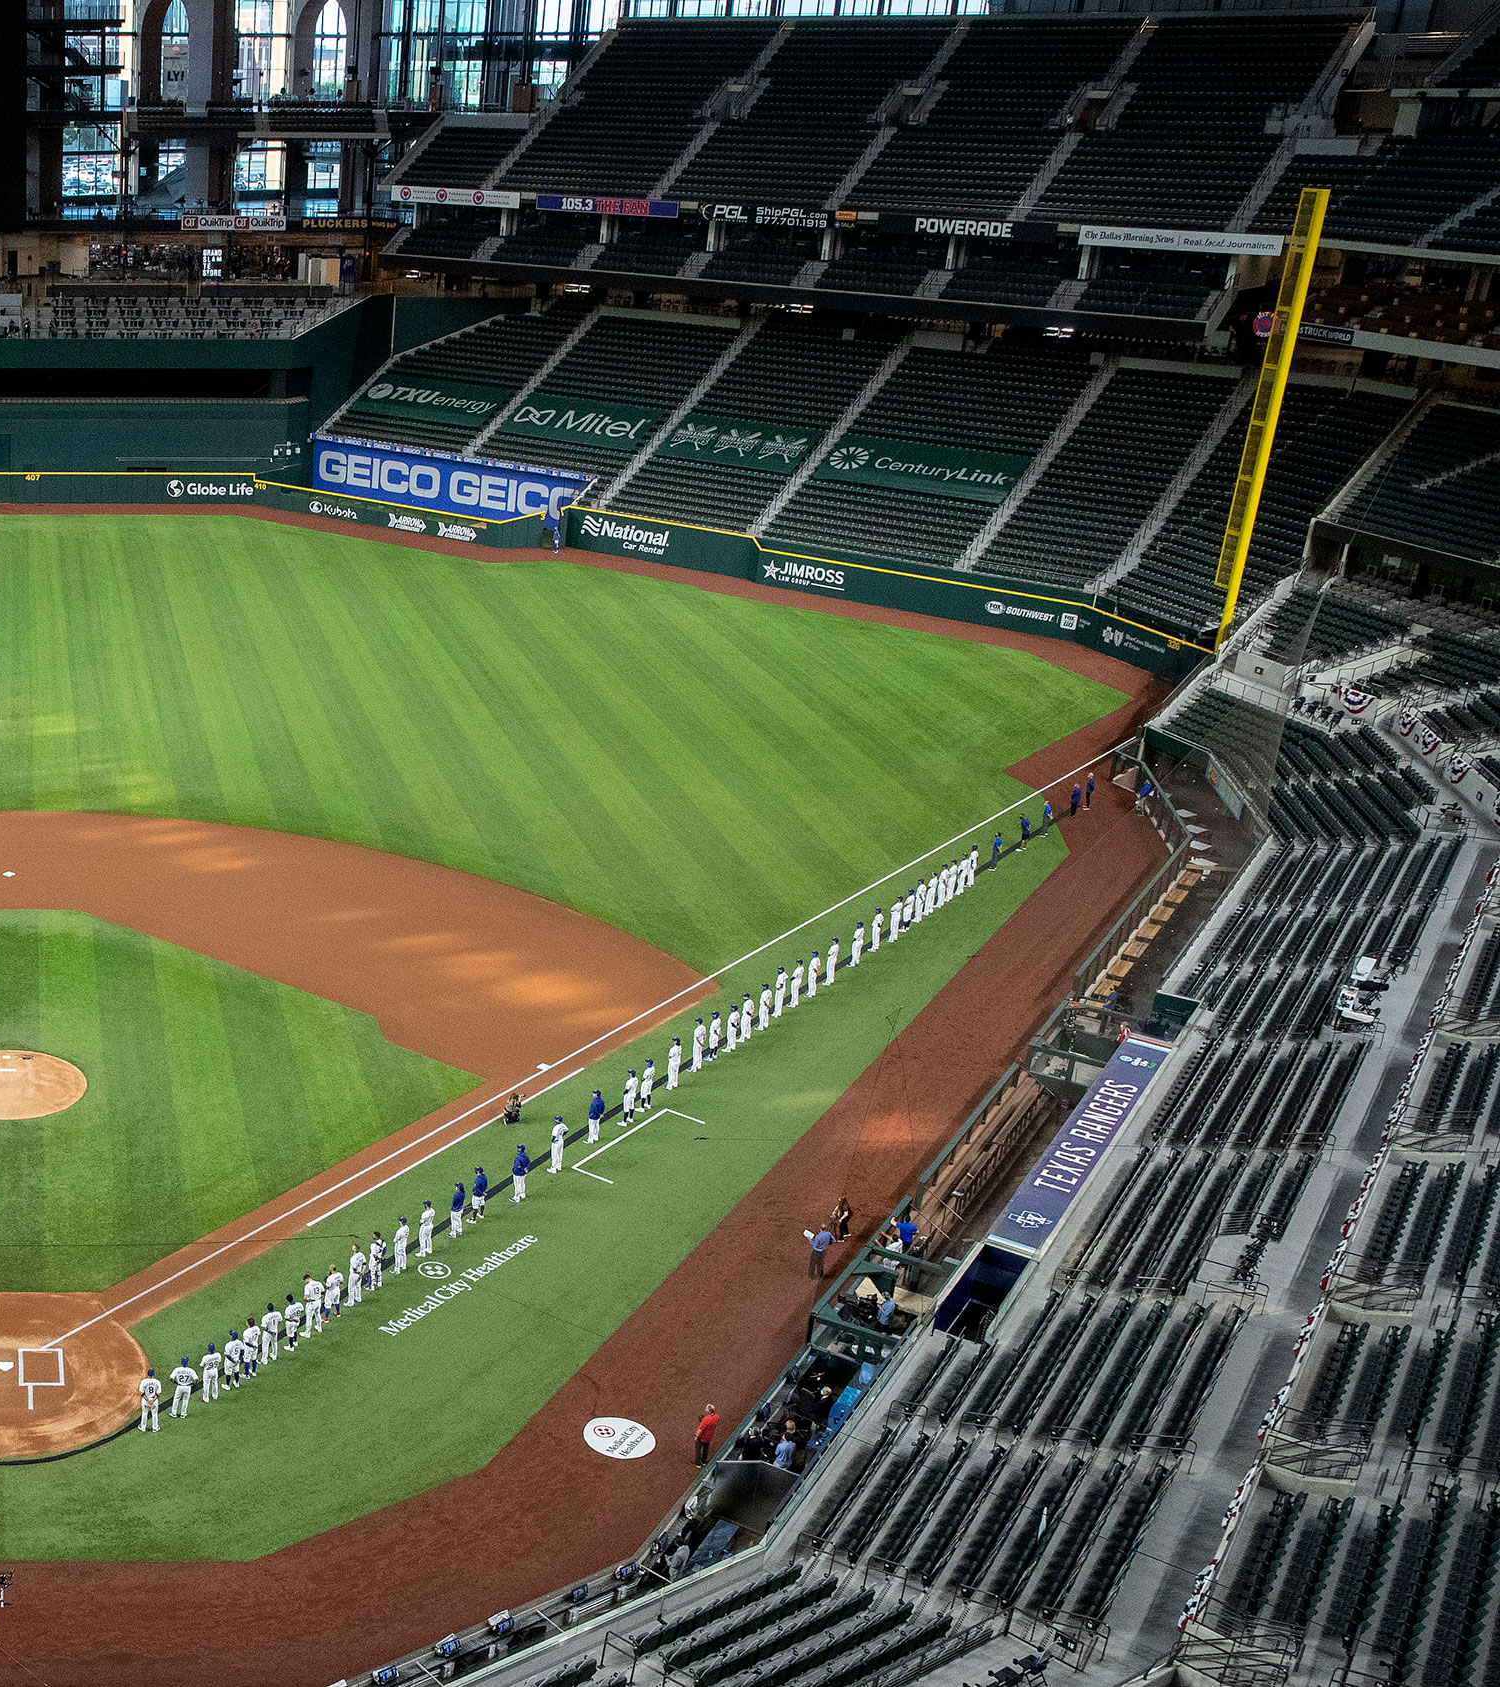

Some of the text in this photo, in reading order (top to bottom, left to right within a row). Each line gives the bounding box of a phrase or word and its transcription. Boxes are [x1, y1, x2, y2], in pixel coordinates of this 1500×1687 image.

[561, 198, 650, 215] 105.3 THE FAN
[713, 205, 748, 219] PGL
[756, 206, 828, 219] ShipPGL.com
[184, 217, 197, 227] QT
[200, 217, 233, 228] QuikTrip
[250, 217, 284, 228] QuikTrip
[303, 218, 368, 229] PLUCKERS
[755, 216, 827, 228] 877.701.1919
[1084, 231, 1098, 240] The
[1099, 231, 1122, 241] Dallas
[1122, 232, 1154, 244] Morning
[1154, 234, 1175, 244] News
[555, 410, 646, 439] Mitel
[319, 450, 441, 499] GEICO
[874, 456, 1009, 486] CenturyLink
[187, 482, 254, 496] Globe Life
[254, 482, 267, 490] 410
[324, 504, 358, 520] Kubota
[397, 516, 421, 527] ARROW
[446, 524, 471, 536] ARROW
[622, 541, 664, 556] Car Rental
[778, 575, 810, 586] LAW GROUP
[990, 602, 1055, 622] FOX SOUTHWEST
[1167, 639, 1180, 651] 326
[1034, 1079, 1139, 1193] TEXAS RANGERS
[378, 1233, 538, 1336] Medical City Healthcare
[179, 1375, 190, 1383] 27
[606, 1424, 640, 1454] Medical City
[619, 1431, 649, 1457] Healthcare
